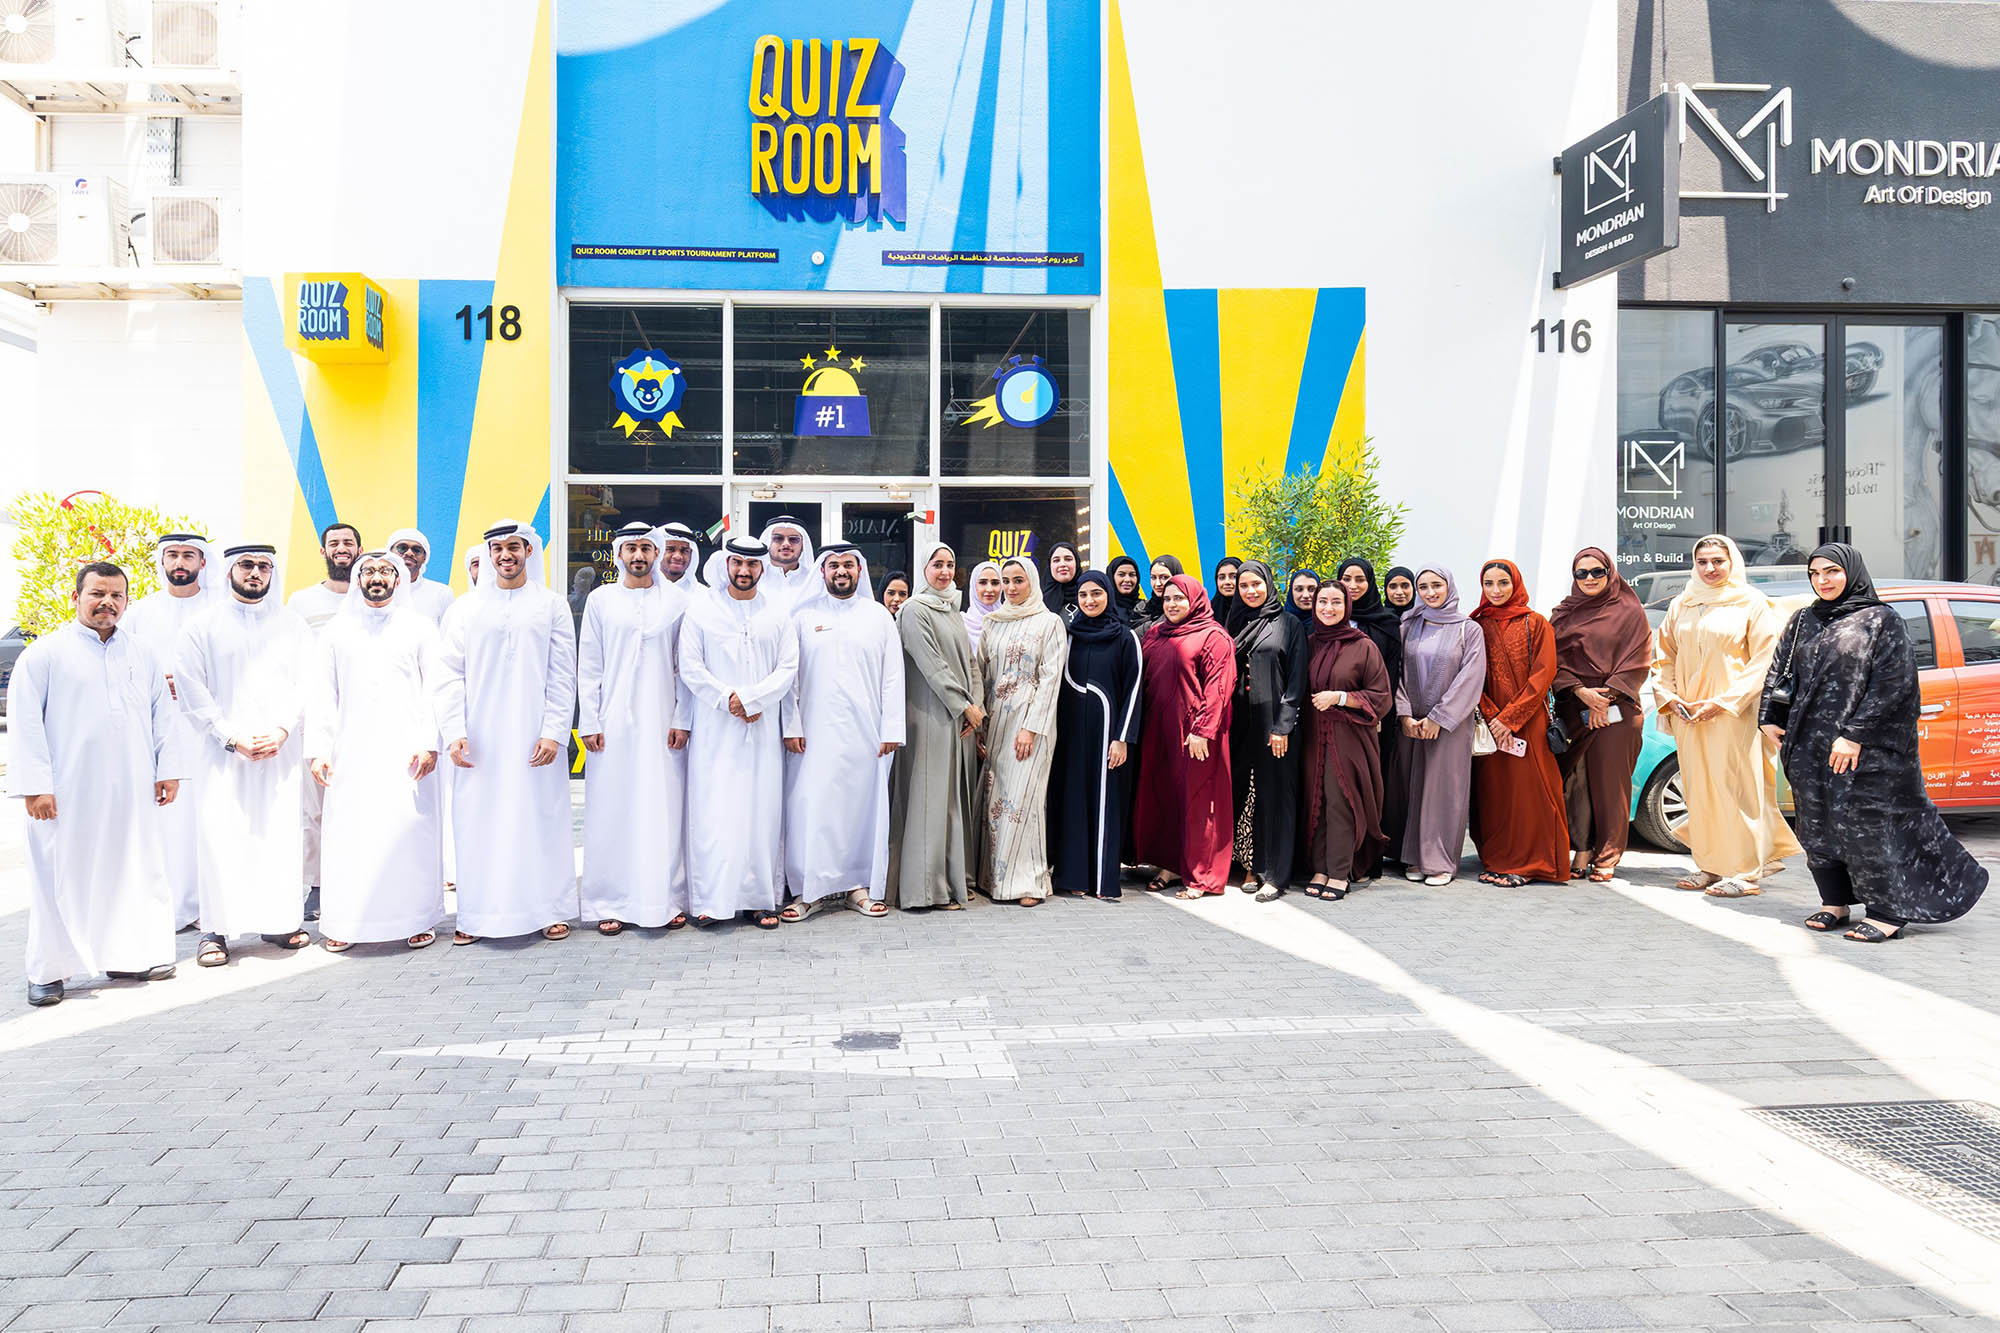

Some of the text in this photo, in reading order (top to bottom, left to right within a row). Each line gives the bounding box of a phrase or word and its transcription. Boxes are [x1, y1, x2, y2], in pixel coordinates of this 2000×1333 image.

[749, 34, 881, 122] QUIZ
[751, 123, 882, 195] ROOM
[1864, 184, 1992, 209] Art Of Design
[1576, 203, 1645, 247] MONDRIAN
[575, 247, 776, 259] QUIZ ROOM CONCEPT E SPORTS TOURNAMENT PLATFORM
[1585, 233, 1634, 260] DESIGN & BUILD
[297, 280, 341, 309] QUIZ
[298, 308, 342, 333] ROOM
[455, 304, 522, 342] 118
[1530, 318, 1592, 353] 116
[815, 404, 846, 429] #1
[1643, 521, 1652, 529] Of
[1653, 522, 1677, 530] Design
[988, 529, 1032, 559] QUIZ
[1616, 553, 1684, 565] sign & Build
